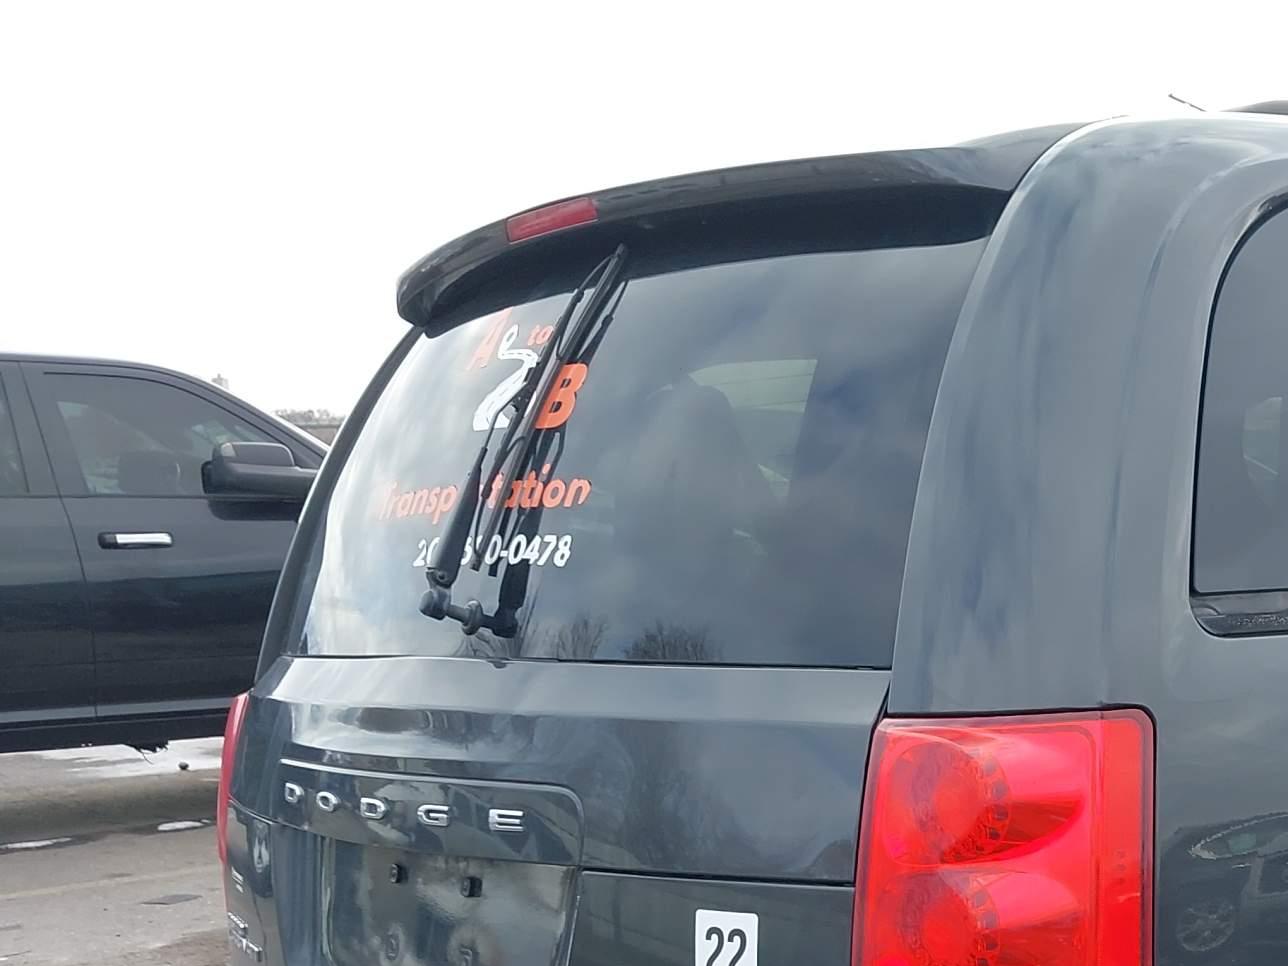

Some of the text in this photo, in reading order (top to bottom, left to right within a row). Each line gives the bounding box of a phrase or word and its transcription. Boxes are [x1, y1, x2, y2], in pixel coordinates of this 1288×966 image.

[465, 306, 589, 430] A to B
[283, 782, 525, 832] DODGE
